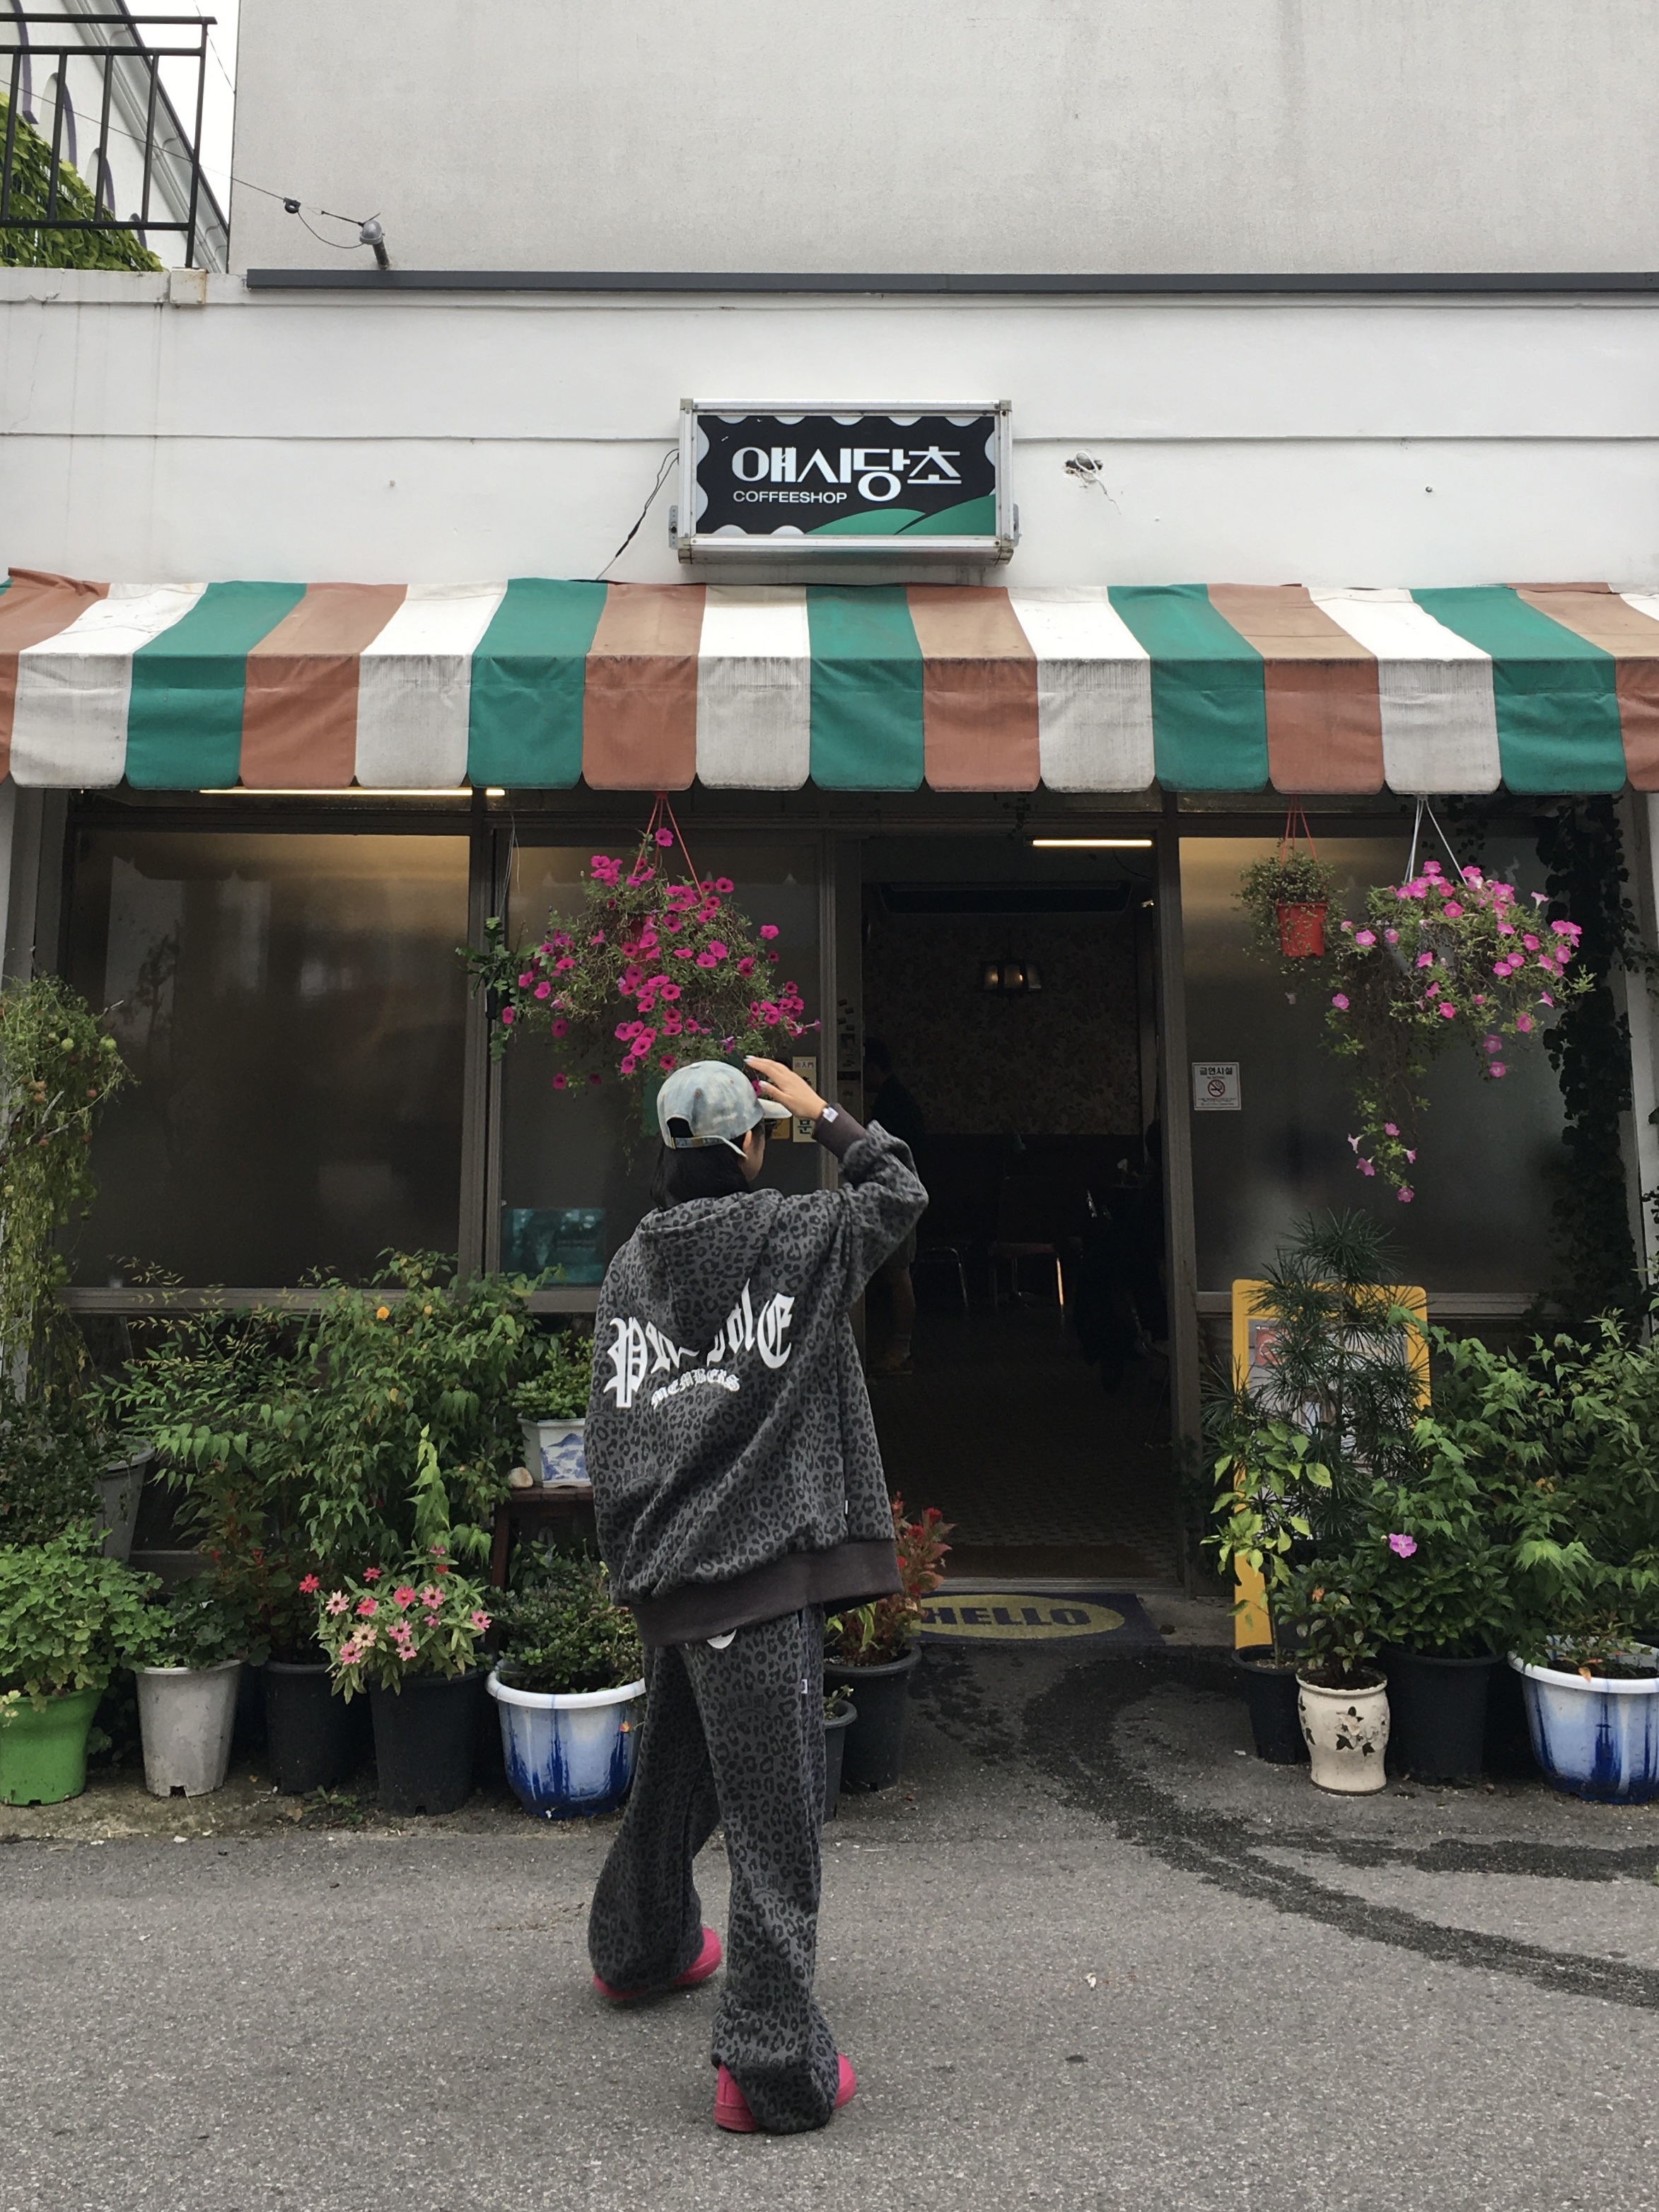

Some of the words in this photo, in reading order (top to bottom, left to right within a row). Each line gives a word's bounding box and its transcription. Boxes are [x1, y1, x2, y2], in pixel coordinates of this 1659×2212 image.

[731, 446, 962, 502] 애시당초
[733, 490, 848, 504] COFFEESHOP
[1199, 1067, 1233, 1076] 금연시설
[921, 1607, 1091, 1626] HELLO
